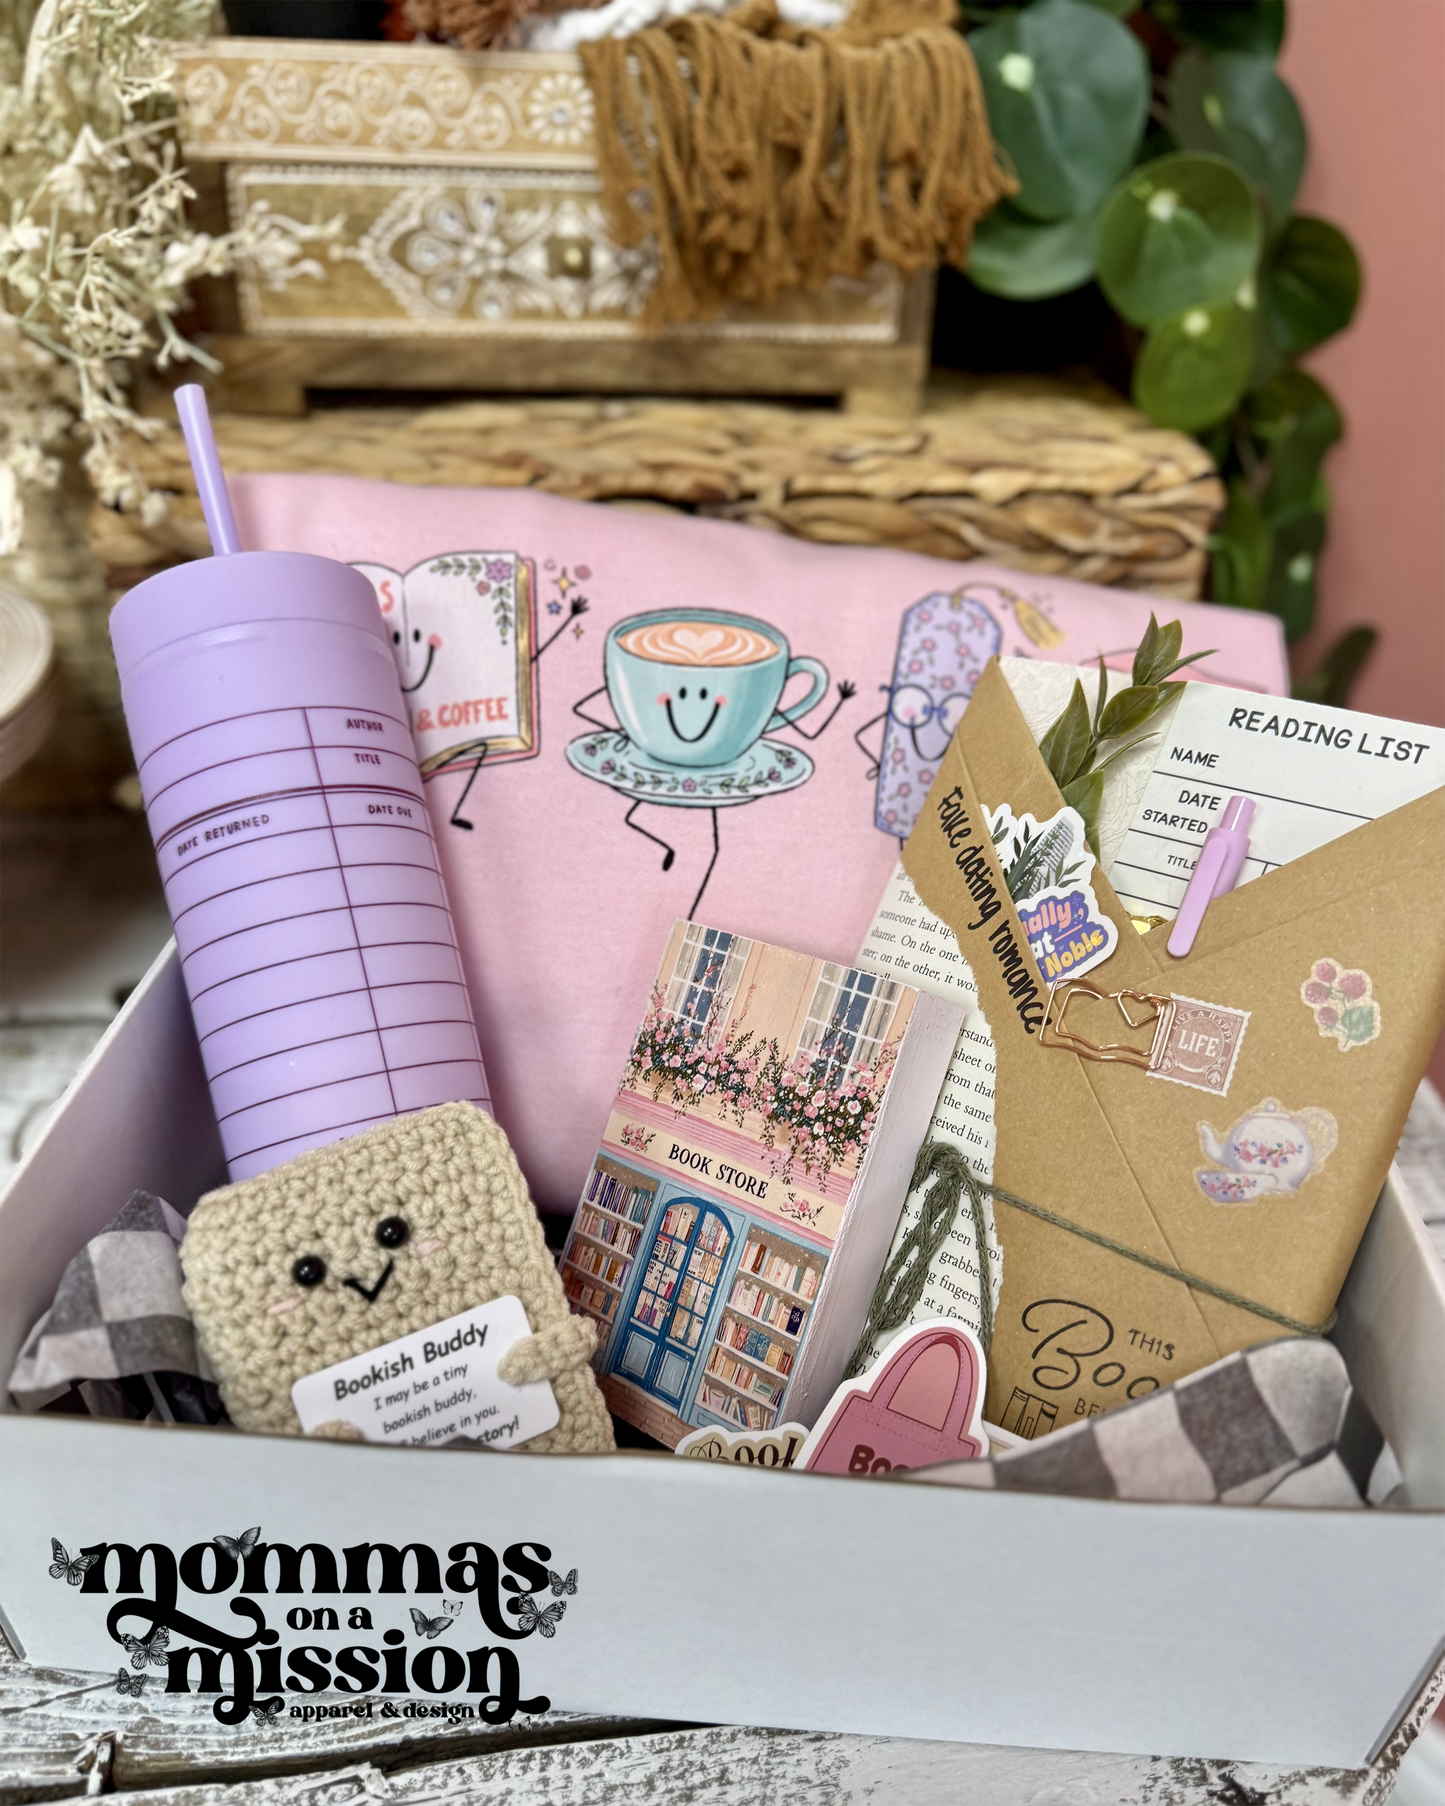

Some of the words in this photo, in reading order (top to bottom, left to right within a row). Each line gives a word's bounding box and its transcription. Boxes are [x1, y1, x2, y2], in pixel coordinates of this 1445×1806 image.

[346, 718, 384, 733] AUTHOR
[416, 709, 435, 732] &
[437, 696, 509, 729] COFFEE
[1228, 707, 1353, 750] READING
[1356, 732, 1431, 765] LIST
[354, 753, 382, 765] TITLE
[1169, 746, 1220, 769] NAME
[368, 804, 393, 815] DATE
[397, 806, 413, 818] DUE
[1177, 790, 1222, 811] DATE
[177, 836, 199, 856] DATE
[204, 814, 270, 842] RETURNED
[1142, 809, 1208, 834] STARTED
[1167, 855, 1198, 870] TITLE
[898, 889, 915, 904] The
[879, 910, 917, 927] someone
[918, 917, 939, 933] had
[870, 926, 897, 943] shame.
[901, 935, 917, 948] On
[919, 941, 936, 955] the
[938, 948, 959, 962] one
[955, 845, 1002, 931] dating
[988, 918, 1052, 1035] romance
[1044, 930, 1104, 978] Noble
[880, 953, 892, 964] on
[894, 955, 911, 969] the
[912, 962, 941, 982] other,
[943, 971, 954, 984] it
[1172, 1012, 1192, 1030] LIVE
[1209, 1012, 1231, 1044] HAPPY
[952, 1048, 982, 1068] sheet
[1177, 1029, 1220, 1058] LIFE
[945, 1069, 970, 1089] from
[974, 1081, 995, 1099] that
[943, 1094, 961, 1110] the
[963, 1105, 992, 1123] same
[967, 1127, 983, 1145] his
[668, 1143, 714, 1176] BOOK
[715, 1163, 769, 1200] STORE
[938, 1250, 982, 1278] grabbe
[924, 1297, 936, 1310] at
[936, 1304, 944, 1314] a
[939, 1274, 981, 1309] fingers,
[1021, 1298, 1160, 1400] Boo
[1128, 1329, 1176, 1361] THIS
[333, 1352, 415, 1401] Bookish
[422, 1323, 488, 1364] Buddy
[374, 1397, 382, 1411] I
[385, 1389, 410, 1406] may
[413, 1379, 429, 1394] be
[432, 1376, 441, 1386] a
[443, 1363, 469, 1379] tiny
[383, 1404, 432, 1434] bookish
[434, 1388, 477, 1412] buddy,
[412, 1421, 457, 1445] believe
[460, 1416, 471, 1428] in
[475, 1405, 500, 1426] you.
